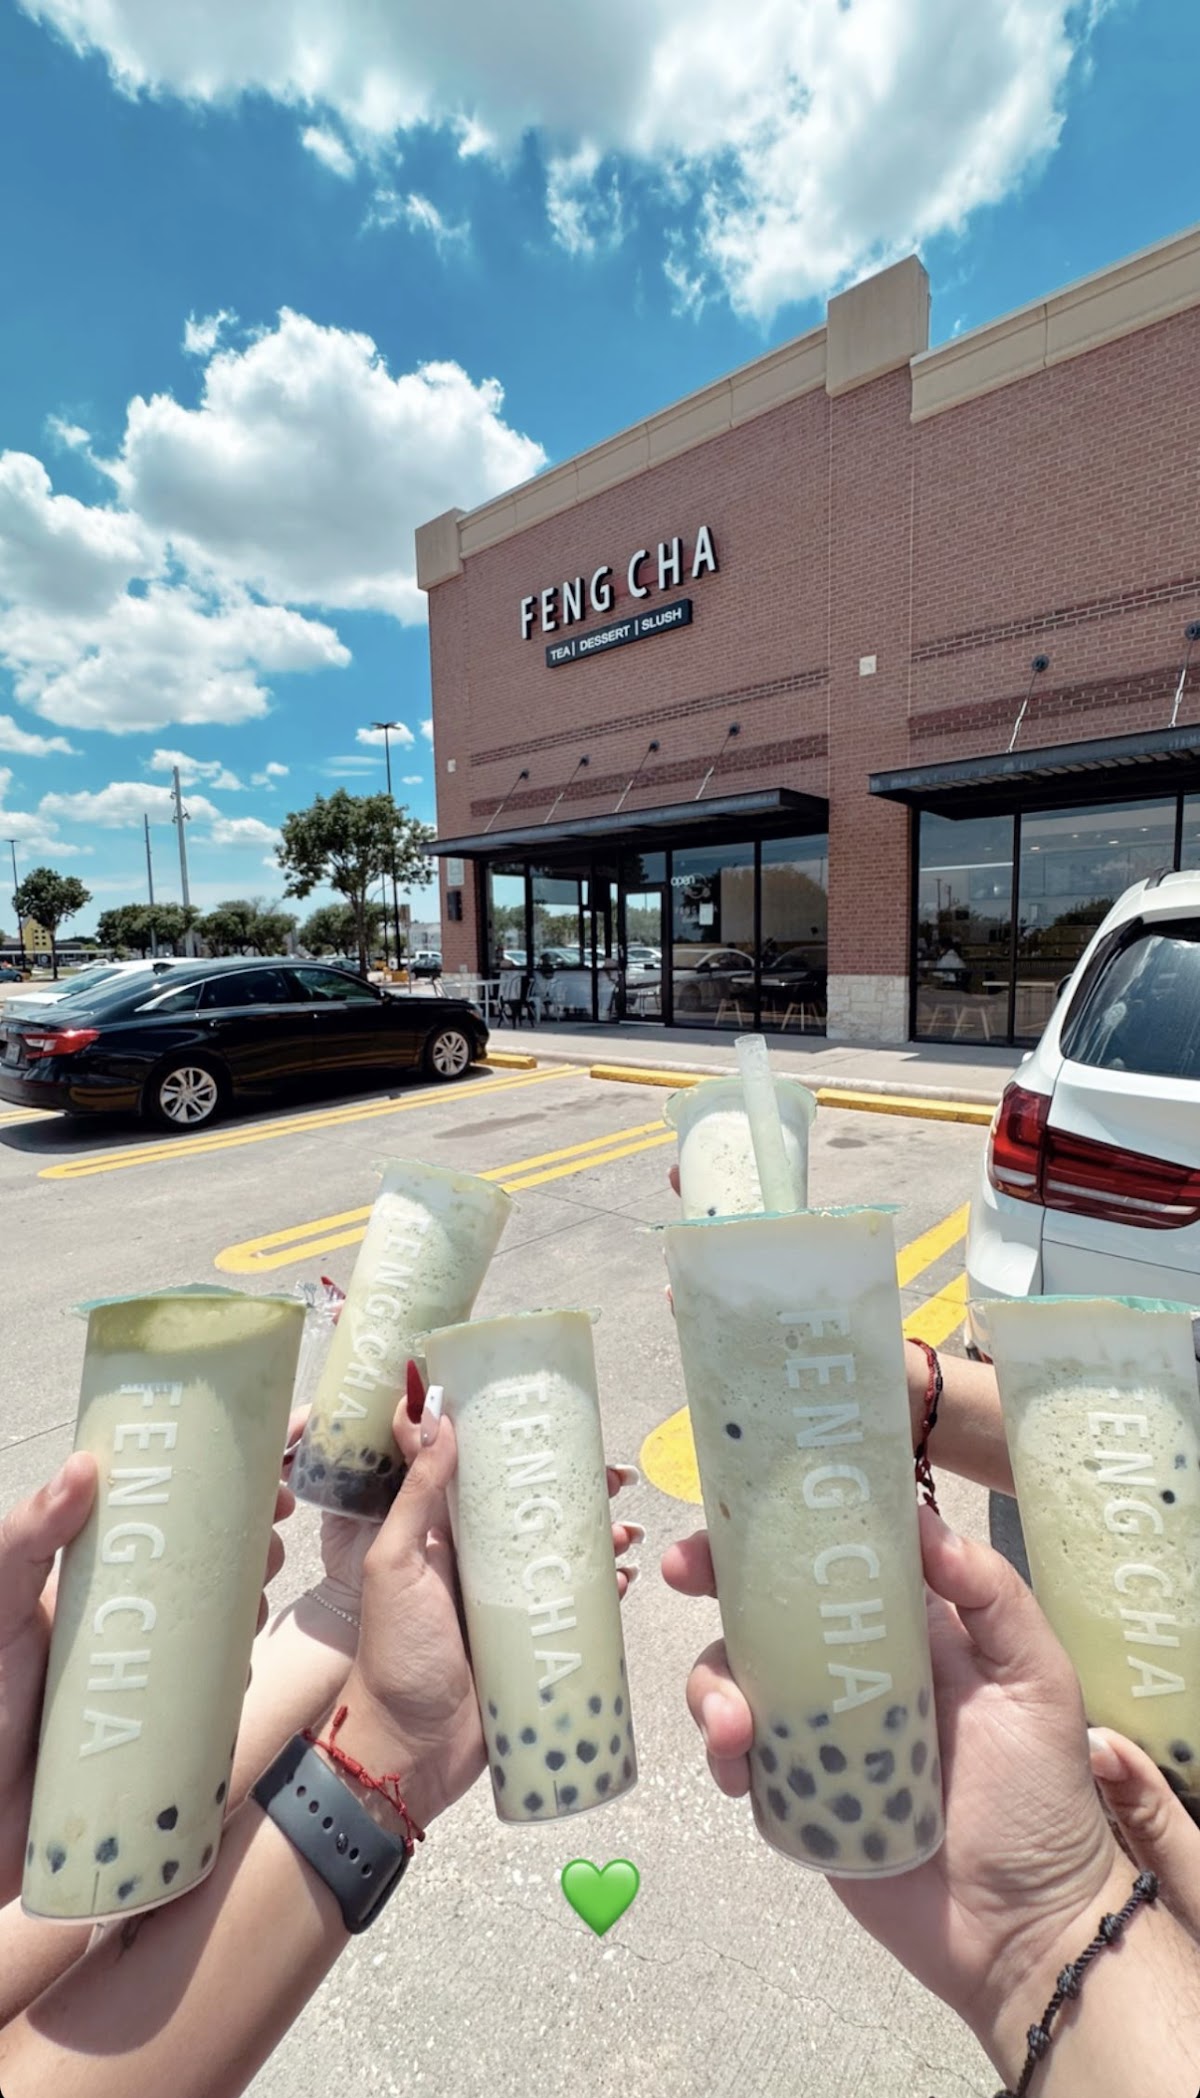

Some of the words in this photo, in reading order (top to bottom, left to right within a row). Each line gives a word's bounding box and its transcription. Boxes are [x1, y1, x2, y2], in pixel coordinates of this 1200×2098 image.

[521, 566, 612, 640] FENG
[627, 526, 717, 599] CHA
[550, 646, 571, 660] TEA
[579, 625, 631, 652] DESSERT
[641, 608, 683, 631] SLUSH
[671, 875, 695, 888] open
[363, 1211, 432, 1321] FENG
[331, 1335, 389, 1421] CHA
[778, 1310, 871, 1510] FENG
[101, 1381, 183, 1565] FENG
[495, 1382, 564, 1536] FENG
[1087, 1383, 1164, 1536] ENG
[80, 1596, 156, 1759] CHA
[522, 1555, 583, 1691] CHA
[813, 1545, 894, 1713] CHA
[1113, 1563, 1187, 1698] CHA
